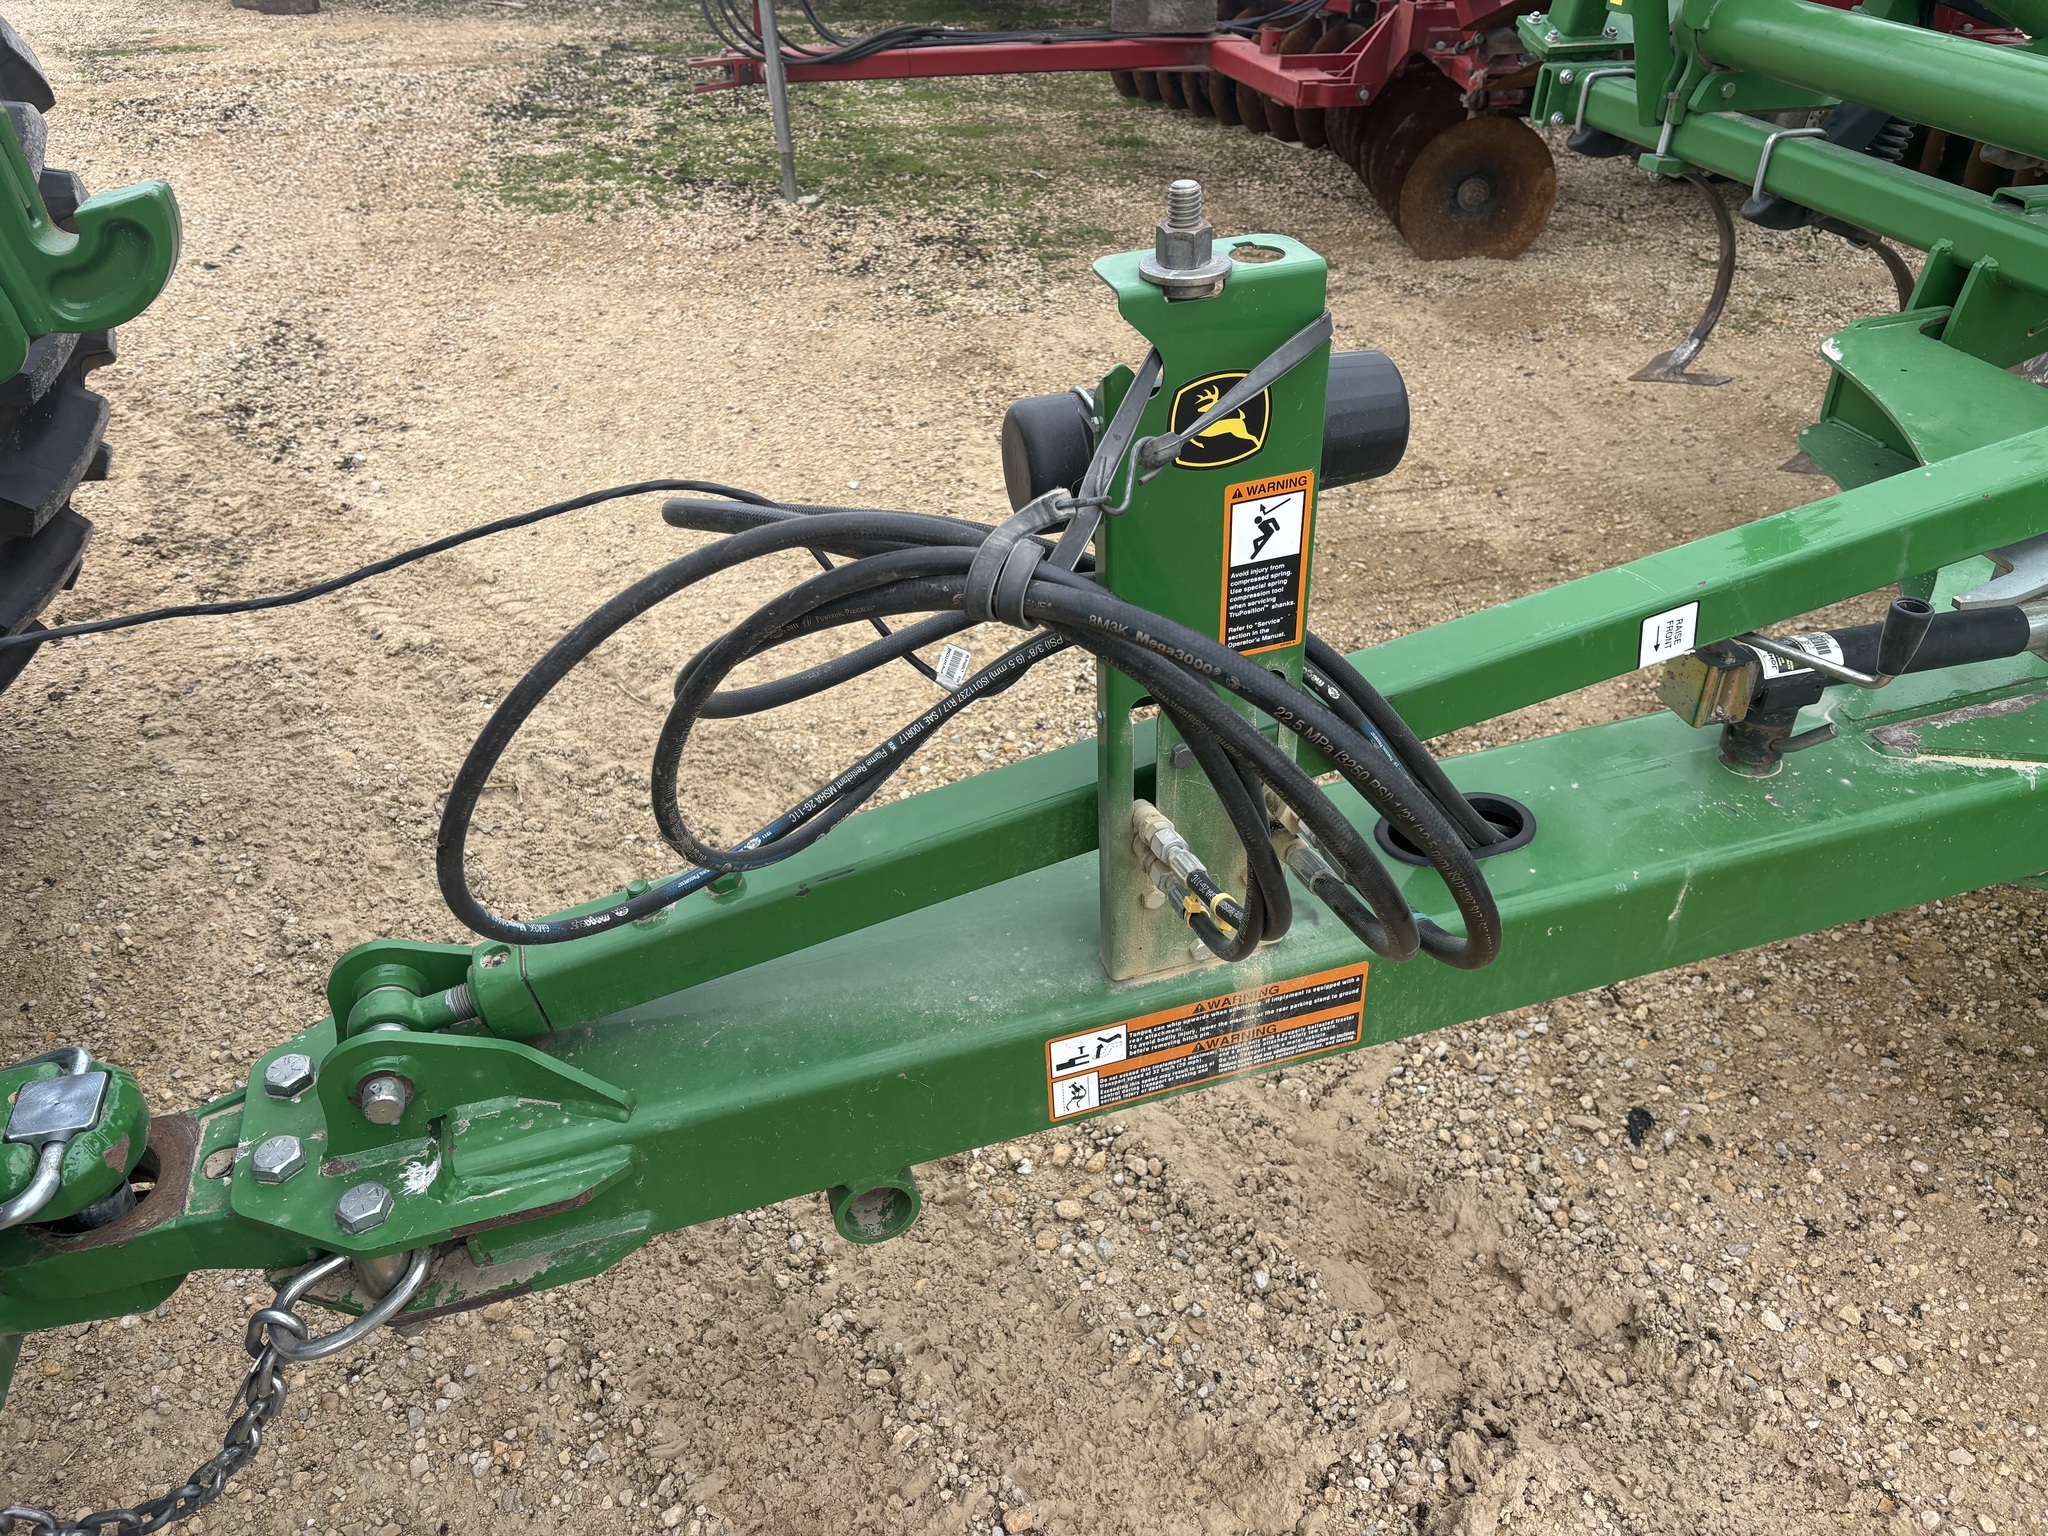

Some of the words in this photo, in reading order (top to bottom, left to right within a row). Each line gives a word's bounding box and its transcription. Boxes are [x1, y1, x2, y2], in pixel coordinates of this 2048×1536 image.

[1246, 474, 1307, 497] WARNING
[1230, 568, 1249, 579] Avoid
[1250, 565, 1268, 576] injury
[1269, 560, 1285, 571] from
[1230, 572, 1269, 589] compressed
[1270, 567, 1292, 580] spring.
[1229, 588, 1270, 605] compression
[1271, 585, 1283, 595] tool
[1230, 586, 1242, 595] Use
[1243, 581, 1266, 594] special
[1267, 576, 1287, 589] spring
[1229, 601, 1246, 611] when
[1247, 594, 1276, 609] servicing
[1271, 597, 1295, 610] shanks.
[1088, 614, 1129, 636] 8M3K
[1227, 630, 1250, 642] section
[1251, 628, 1258, 636] in
[1259, 626, 1269, 634] the
[1228, 623, 1245, 634] Refer
[1246, 622, 1253, 630] to
[1664, 620, 1675, 649] FRONT
[1673, 617, 1684, 645] RAISE
[1043, 634, 1064, 651] PSI)
[1227, 634, 1260, 650] Operator's
[1261, 629, 1285, 642] Manual.
[1008, 653, 1026, 670] (9.5
[1027, 644, 1044, 661] 3/8"
[989, 664, 1009, 683] mm)
[942, 697, 958, 715] R17
[922, 711, 940, 727] SAE
[898, 722, 925, 746] 100R17
[867, 748, 889, 767] Flame
[1305, 726, 1335, 754] MPa
[1335, 749, 1371, 783] (3250
[834, 761, 869, 790] Resistant
[815, 783, 838, 806] MSHA
[788, 798, 818, 825] 2G-11C
[1129, 1027, 1151, 1039] Tongue
[1153, 1024, 1165, 1032] can
[1166, 1019, 1181, 1029] whip
[1182, 1013, 1209, 1025] upwards
[1210, 1008, 1227, 1018] when
[1271, 989, 1304, 1003] implement
[1312, 980, 1340, 993] equipped
[1341, 976, 1354, 985] with
[1207, 984, 1279, 1010] WARNING
[1129, 1042, 1136, 1050] To
[1138, 1037, 1155, 1048] avoid
[1156, 1032, 1176, 1044] bodily
[1199, 1022, 1216, 1032] lower
[1217, 1019, 1228, 1027] the
[1264, 1007, 1274, 1015] the
[1275, 1004, 1289, 1013] rear
[1289, 998, 1312, 1010] parking
[1313, 994, 1330, 1004] stand
[1338, 987, 1359, 999] ground
[1129, 1036, 1142, 1044] rear
[1129, 1045, 1149, 1056] before
[1151, 1037, 1180, 1051] removing
[1182, 1032, 1198, 1042] hitch
[1199, 1029, 1211, 1038] pin.
[1206, 1023, 1276, 1049] WARNING
